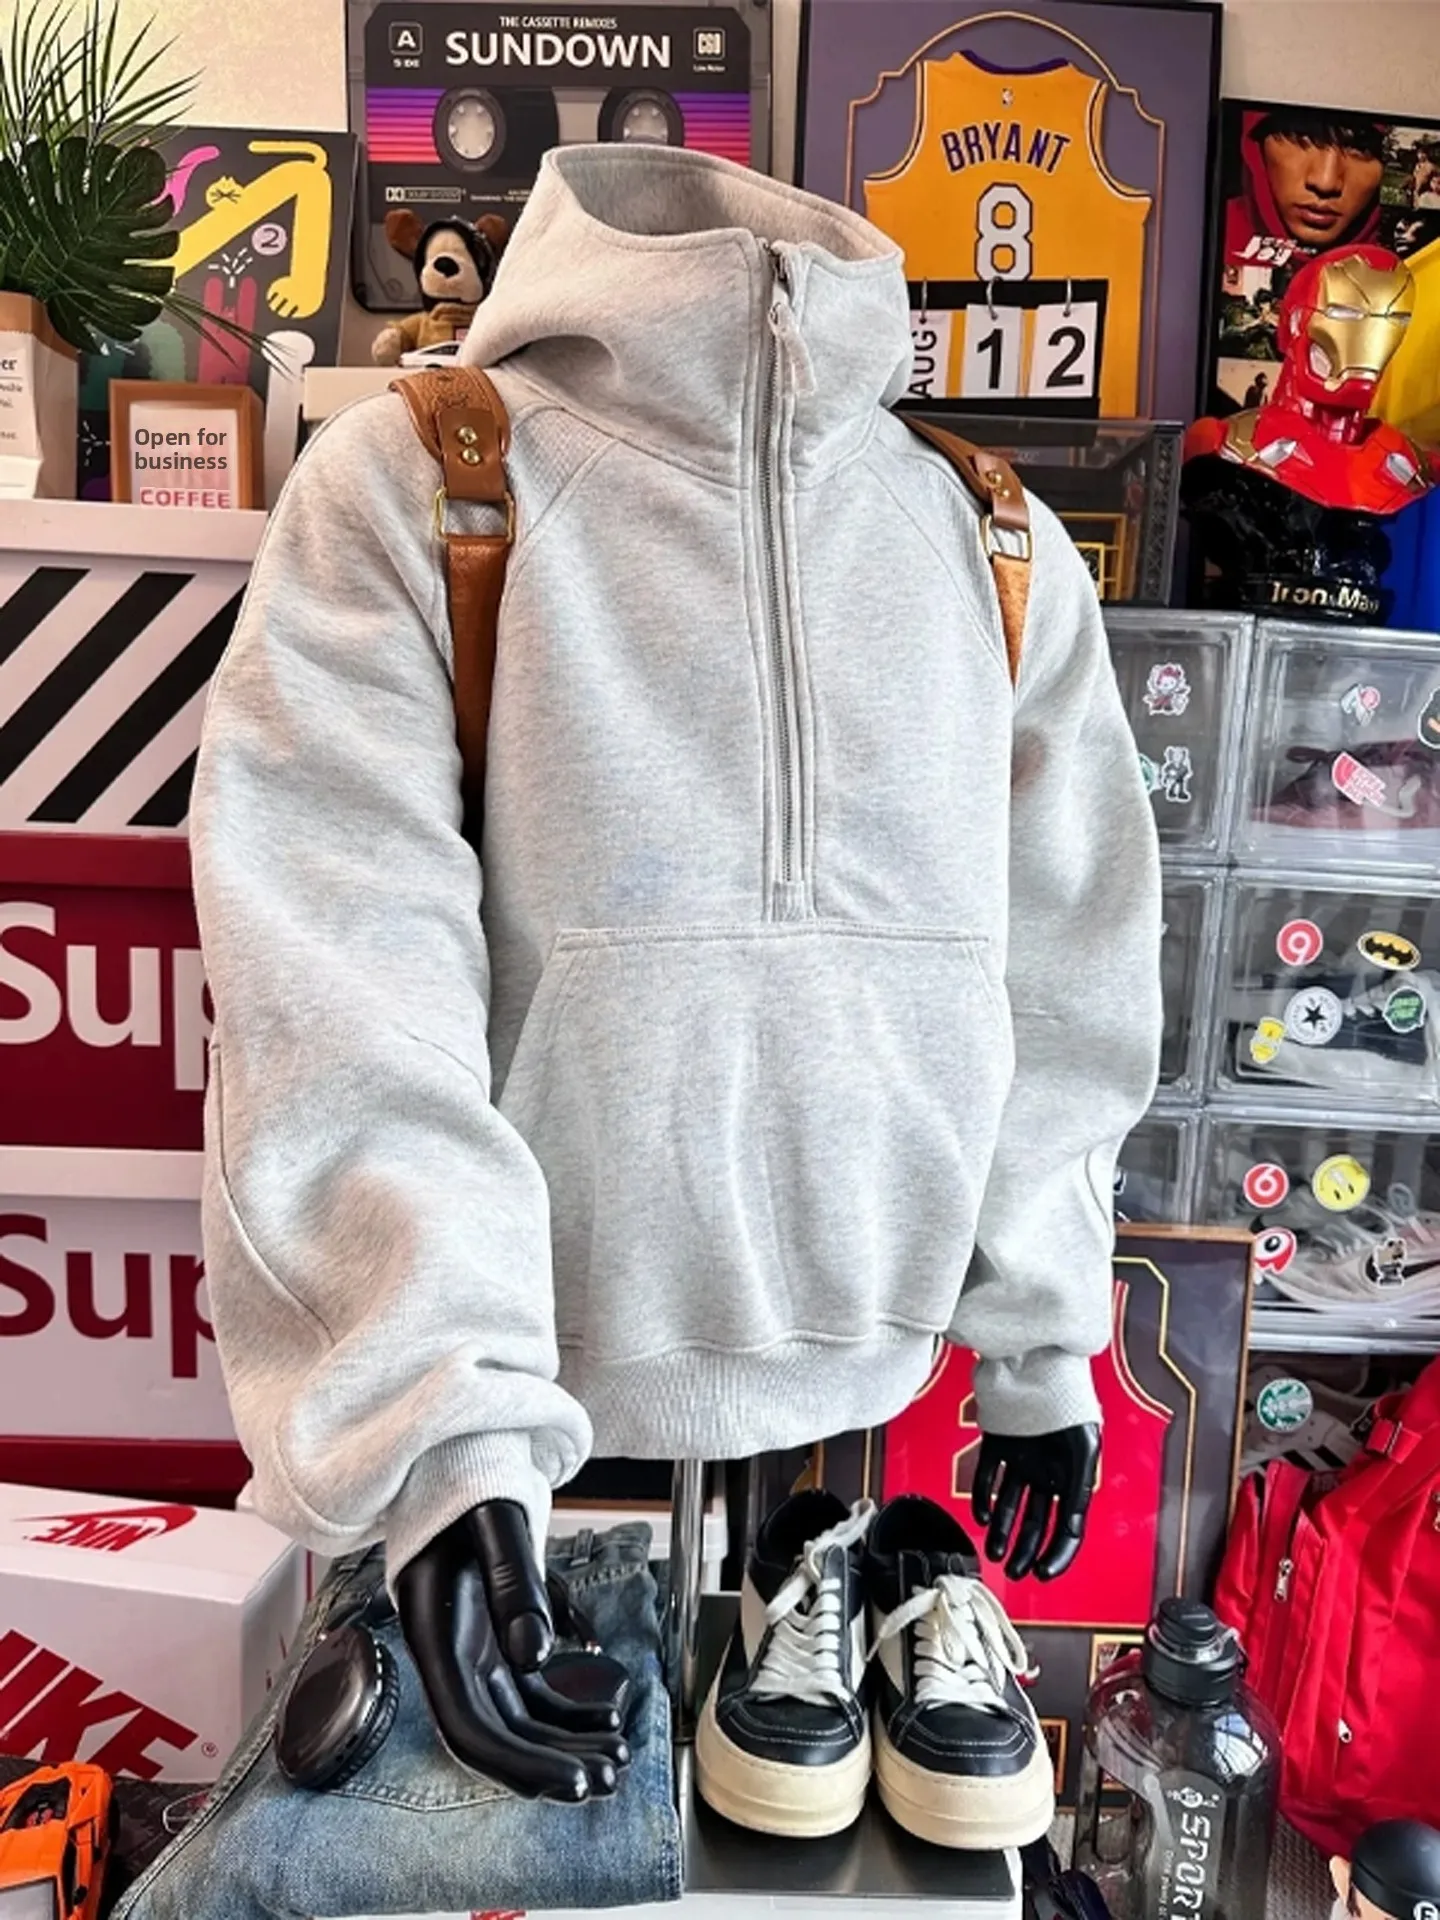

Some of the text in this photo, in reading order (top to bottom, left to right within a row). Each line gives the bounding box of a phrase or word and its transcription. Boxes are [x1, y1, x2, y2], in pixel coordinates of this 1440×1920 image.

[397, 29, 416, 48] A
[445, 31, 671, 68] SUNDOWN
[393, 58, 420, 68] SDE
[940, 120, 1071, 174] BRYANT
[260, 227, 280, 249] 2
[974, 181, 1034, 281] 8
[907, 326, 1086, 399] AUG 1 2
[135, 428, 227, 449] Open for
[135, 452, 227, 469] business
[140, 489, 231, 509] COFFEE
[30, 1517, 158, 1551] NIKE
